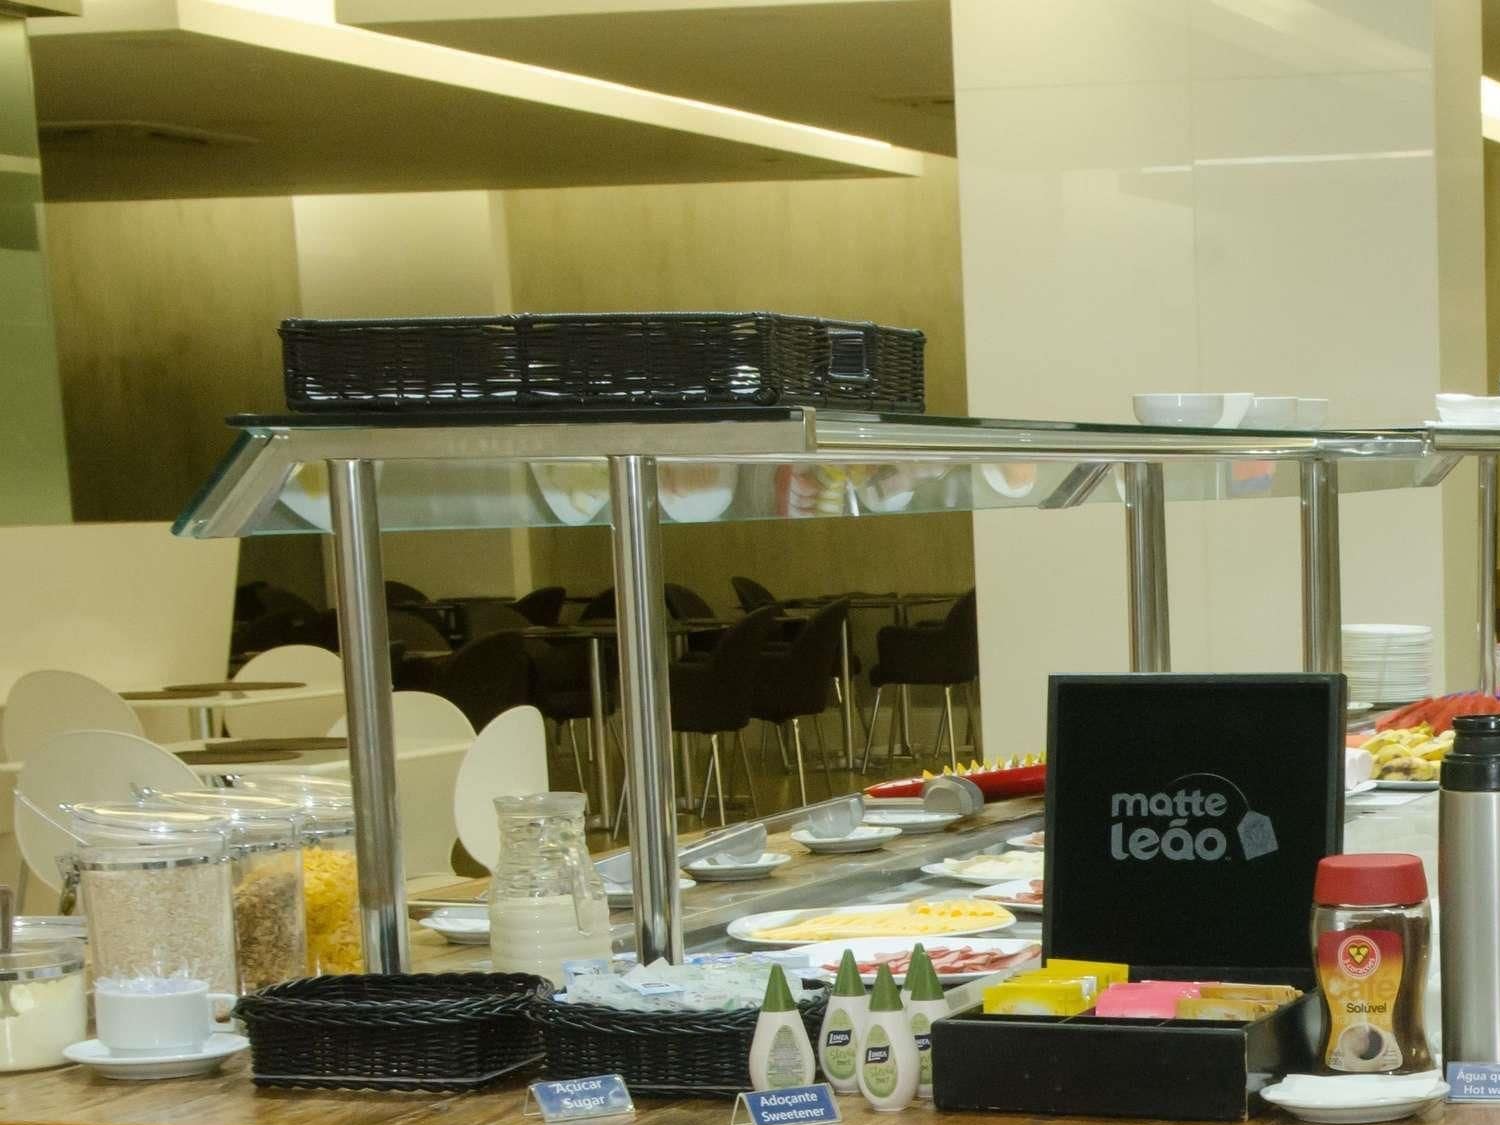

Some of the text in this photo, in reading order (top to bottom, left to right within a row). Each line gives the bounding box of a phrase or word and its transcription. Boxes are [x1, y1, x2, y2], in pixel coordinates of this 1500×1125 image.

[1111, 788, 1228, 818] matte
[1111, 818, 1227, 861] leão
[1346, 1002, 1388, 1015] Solúvel
[1463, 1085, 1485, 1095] Hot
[561, 1096, 606, 1110] Sugar
[760, 1091, 818, 1107] Adoçante
[762, 1106, 825, 1122] Sweetener
